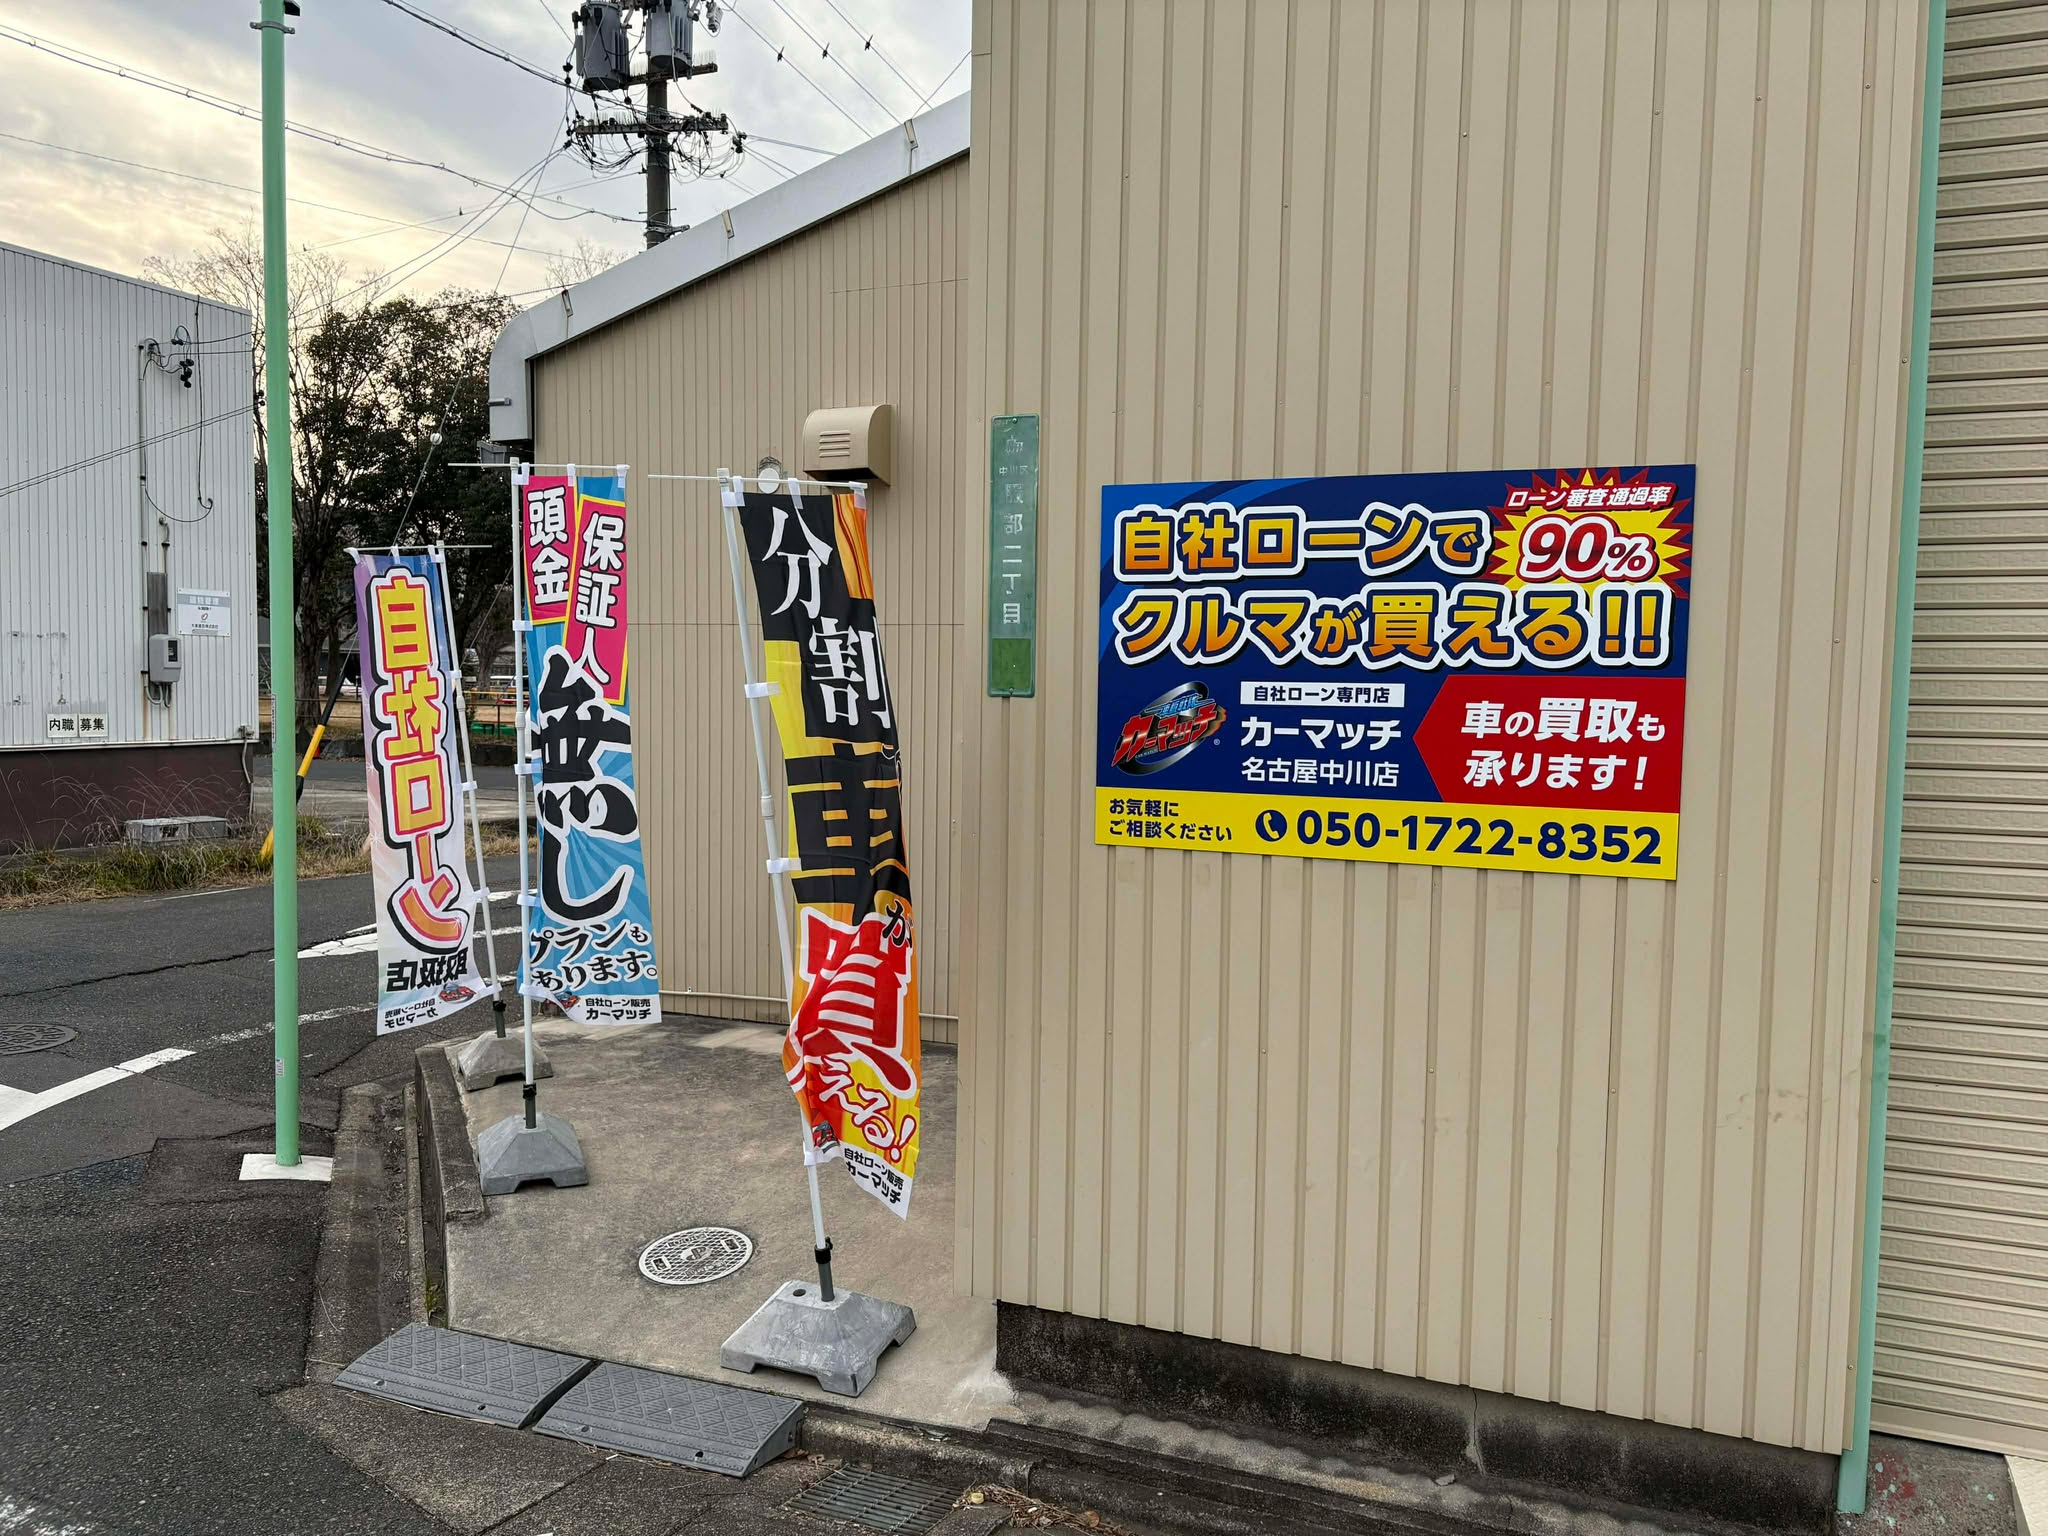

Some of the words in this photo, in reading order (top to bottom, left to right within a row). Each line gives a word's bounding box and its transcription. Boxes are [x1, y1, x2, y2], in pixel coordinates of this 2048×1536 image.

[1507, 485, 1672, 508] ローン審査通過率
[528, 486, 569, 604] 頭金
[1120, 508, 1488, 574] 自社ローンで
[1522, 519, 1650, 576] 90%
[575, 512, 626, 685] 保証人
[762, 506, 902, 780] 分割
[1116, 588, 1660, 664] クルマが買える!!
[1253, 685, 1391, 704] 自社ローン専門店
[1111, 703, 1217, 767] カーマッチ
[1240, 716, 1402, 751] カーマッチ
[1461, 697, 1666, 743] 車の買取も
[532, 652, 639, 922] 無し
[1241, 757, 1400, 788] 名古屋中川店
[1464, 750, 1648, 791] 承ります!
[1109, 798, 1180, 818] お気軽に
[1109, 819, 1233, 842] ご相談ください
[1297, 809, 1662, 865] 050-1722-8352
[531, 922, 648, 965] プランも
[532, 950, 659, 992] あります。
[585, 998, 651, 1008] 自社ローン販売
[586, 1008, 652, 1020] カーマッチ
[845, 1161, 902, 1204] カーマッチ
